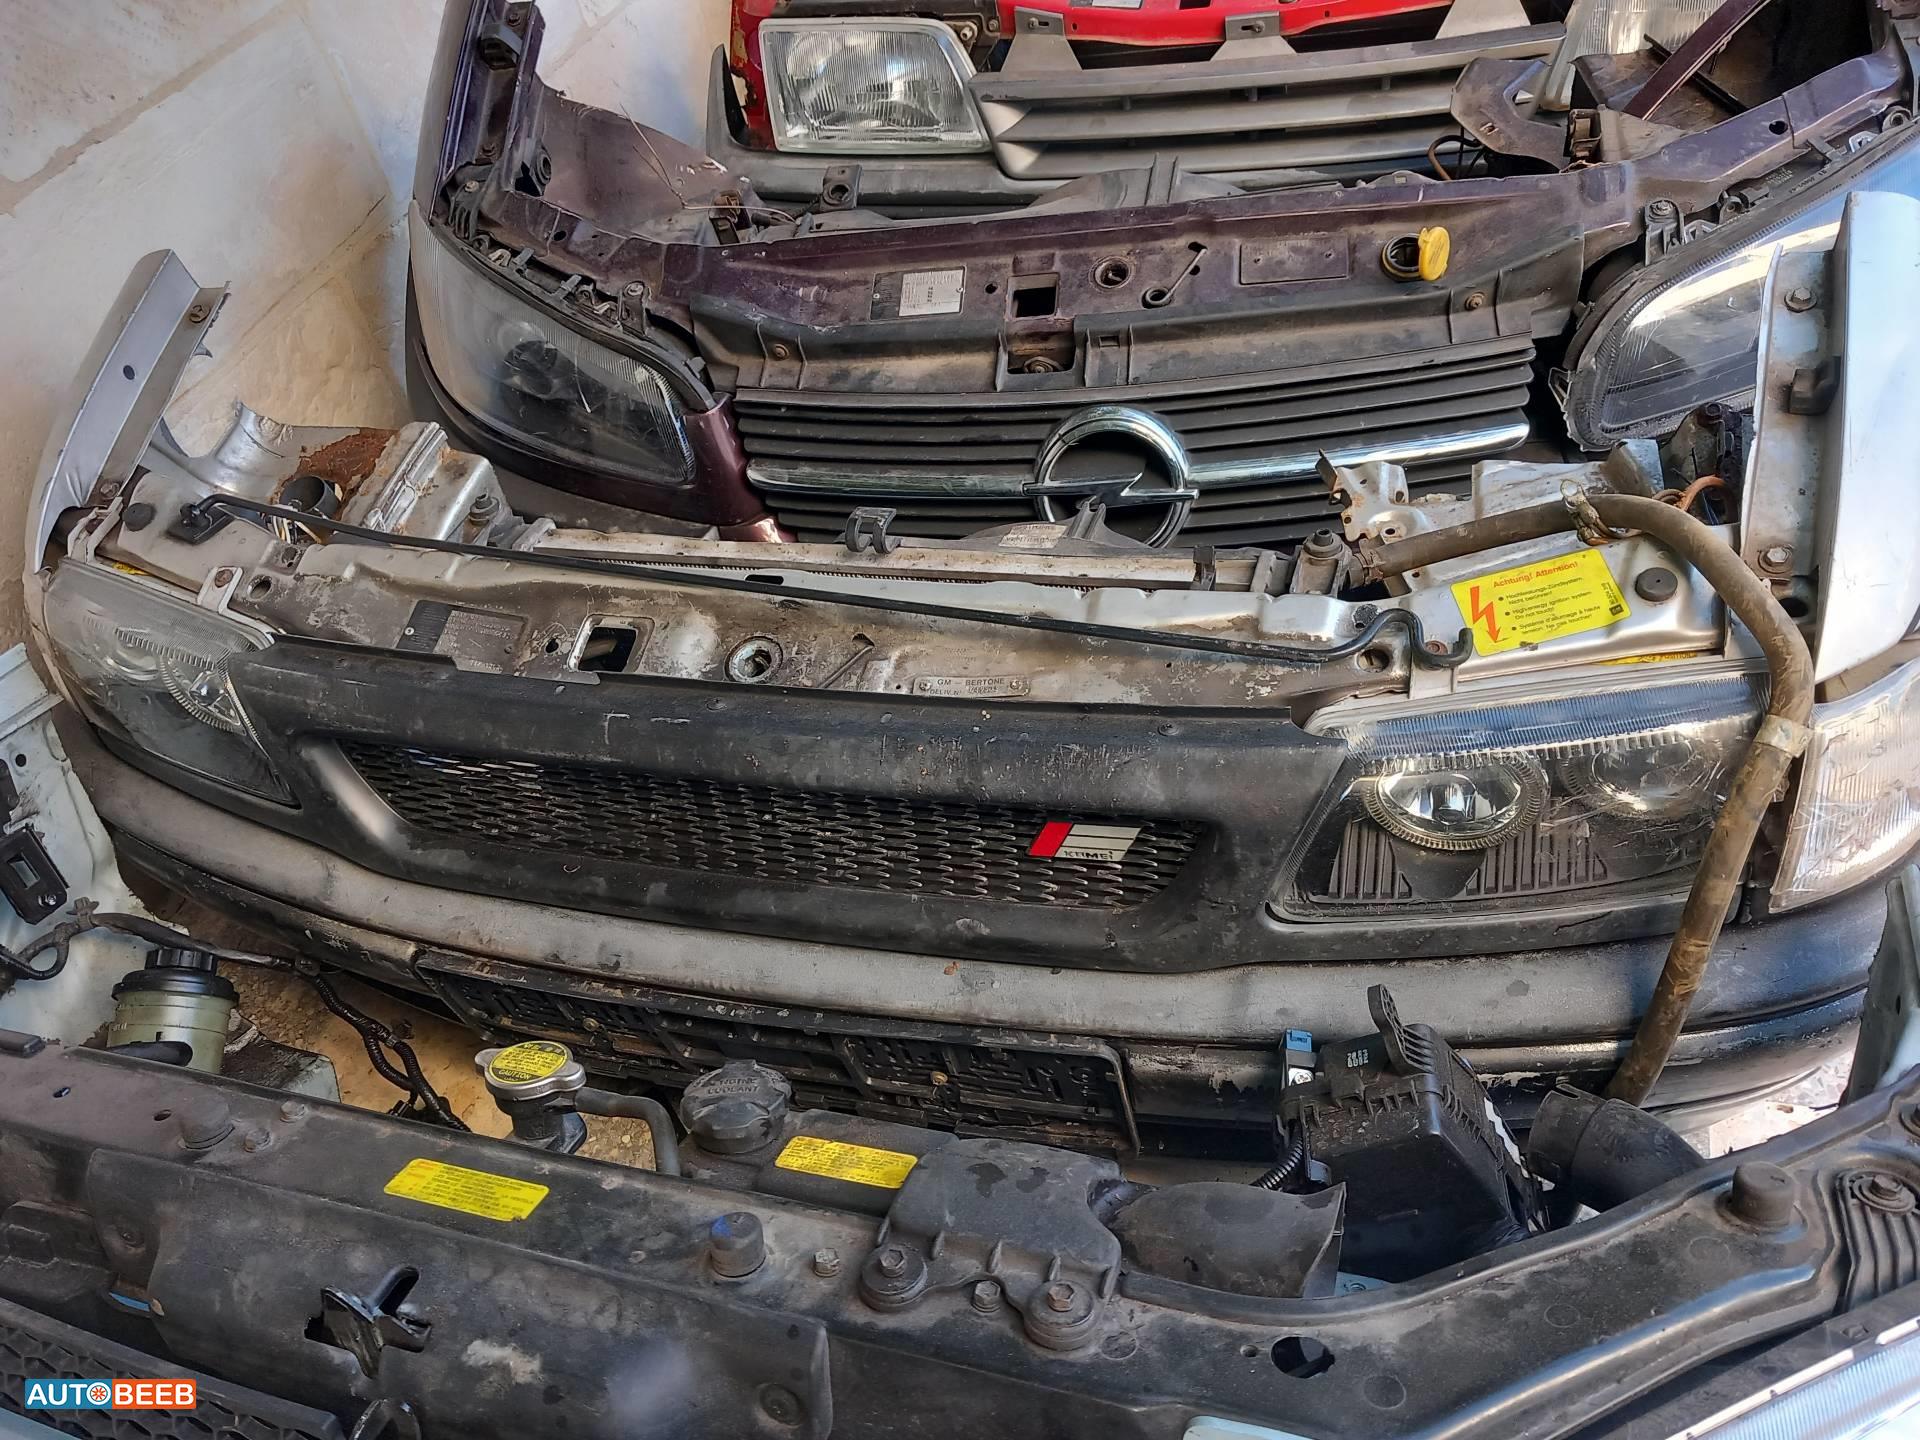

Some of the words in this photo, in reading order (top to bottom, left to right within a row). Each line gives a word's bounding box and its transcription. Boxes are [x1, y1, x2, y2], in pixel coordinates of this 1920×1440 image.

[1493, 572, 1533, 588] Achtung!
[1535, 561, 1578, 578] Attention!
[937, 678, 952, 686] GM
[965, 677, 1005, 687] BERTONE
[498, 1069, 532, 1080] CAUTION
